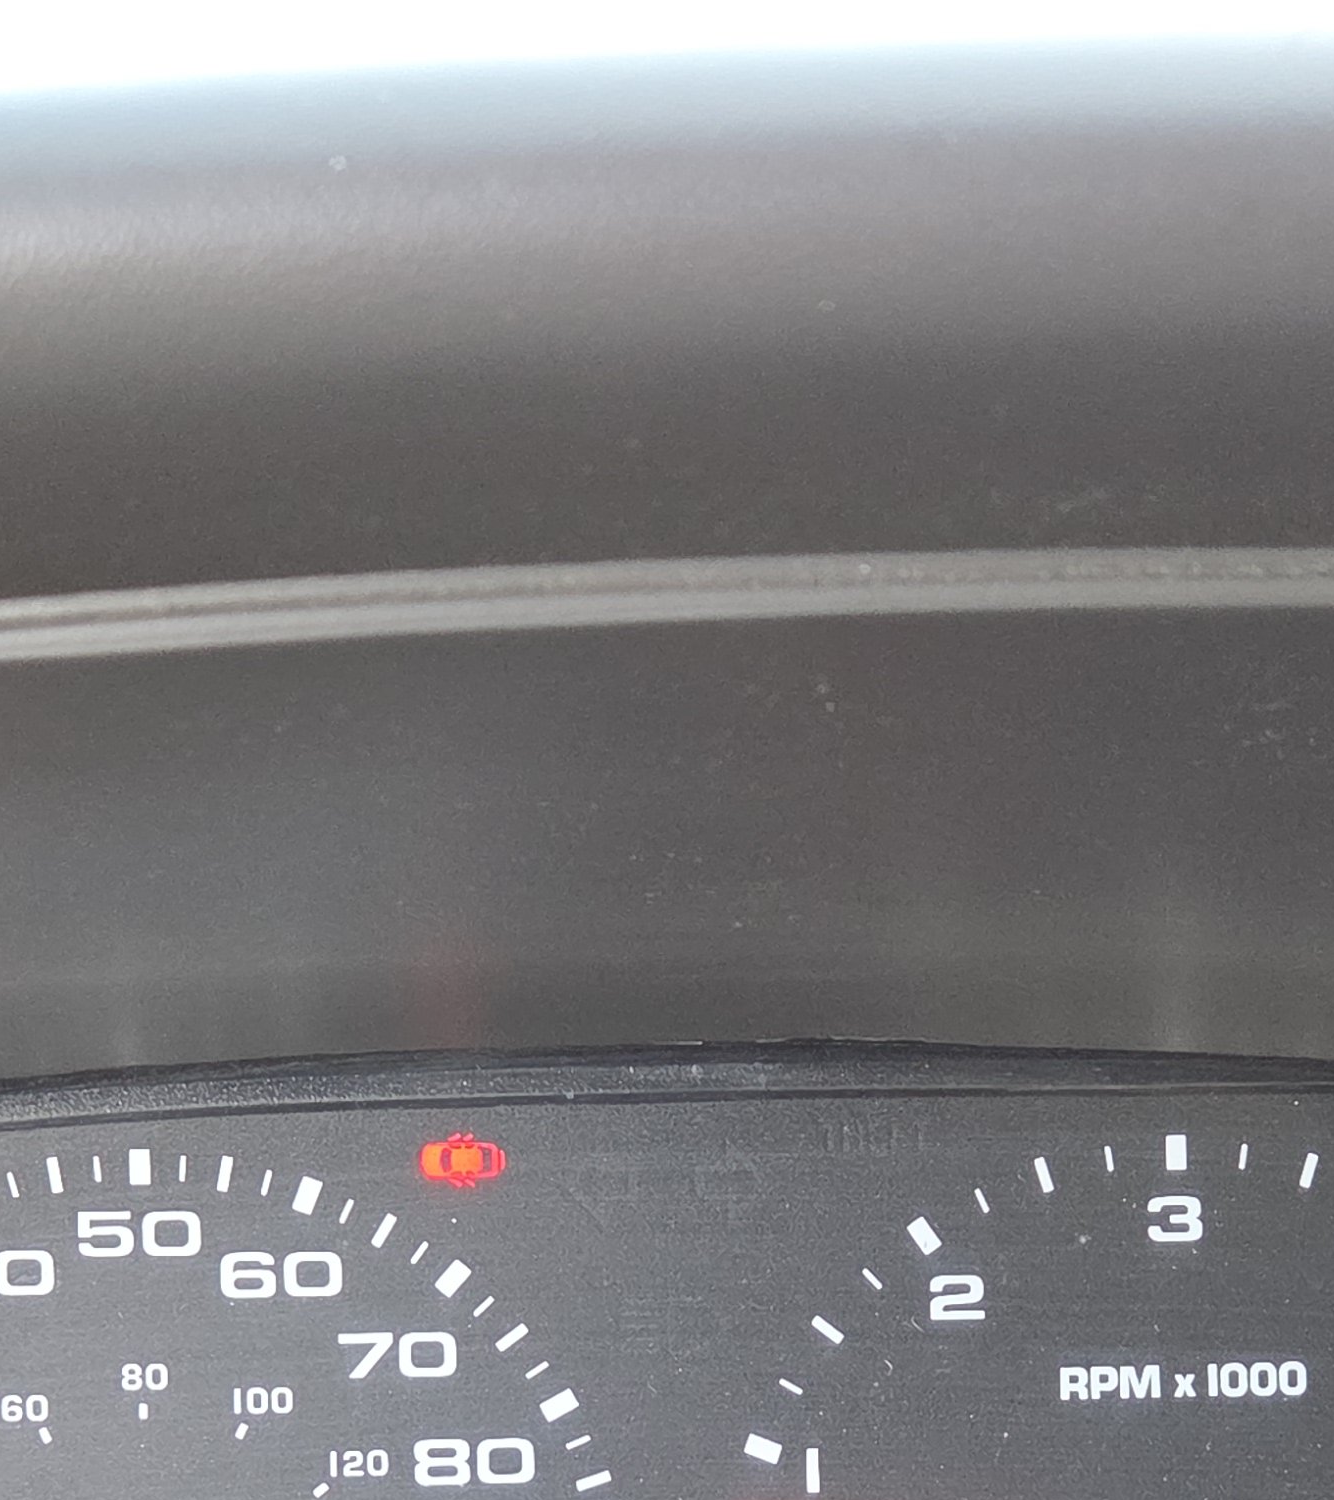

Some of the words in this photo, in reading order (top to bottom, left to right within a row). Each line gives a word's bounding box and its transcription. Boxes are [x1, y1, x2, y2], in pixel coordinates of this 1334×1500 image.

[78, 1211, 201, 1257] 50
[1147, 1196, 1202, 1242] 3
[220, 1252, 342, 1298] 60
[930, 1275, 985, 1320] 2
[122, 1364, 168, 1391] 80
[338, 1332, 456, 1379] 70
[234, 1387, 293, 1414] 100
[1060, 1365, 1161, 1400] RPM
[1174, 1374, 1196, 1398] x
[1208, 1361, 1306, 1397] 1000
[1, 1395, 48, 1422] 60
[330, 1450, 389, 1477] 120
[414, 1438, 535, 1487] 80
[806, 1448, 820, 1493] 1
